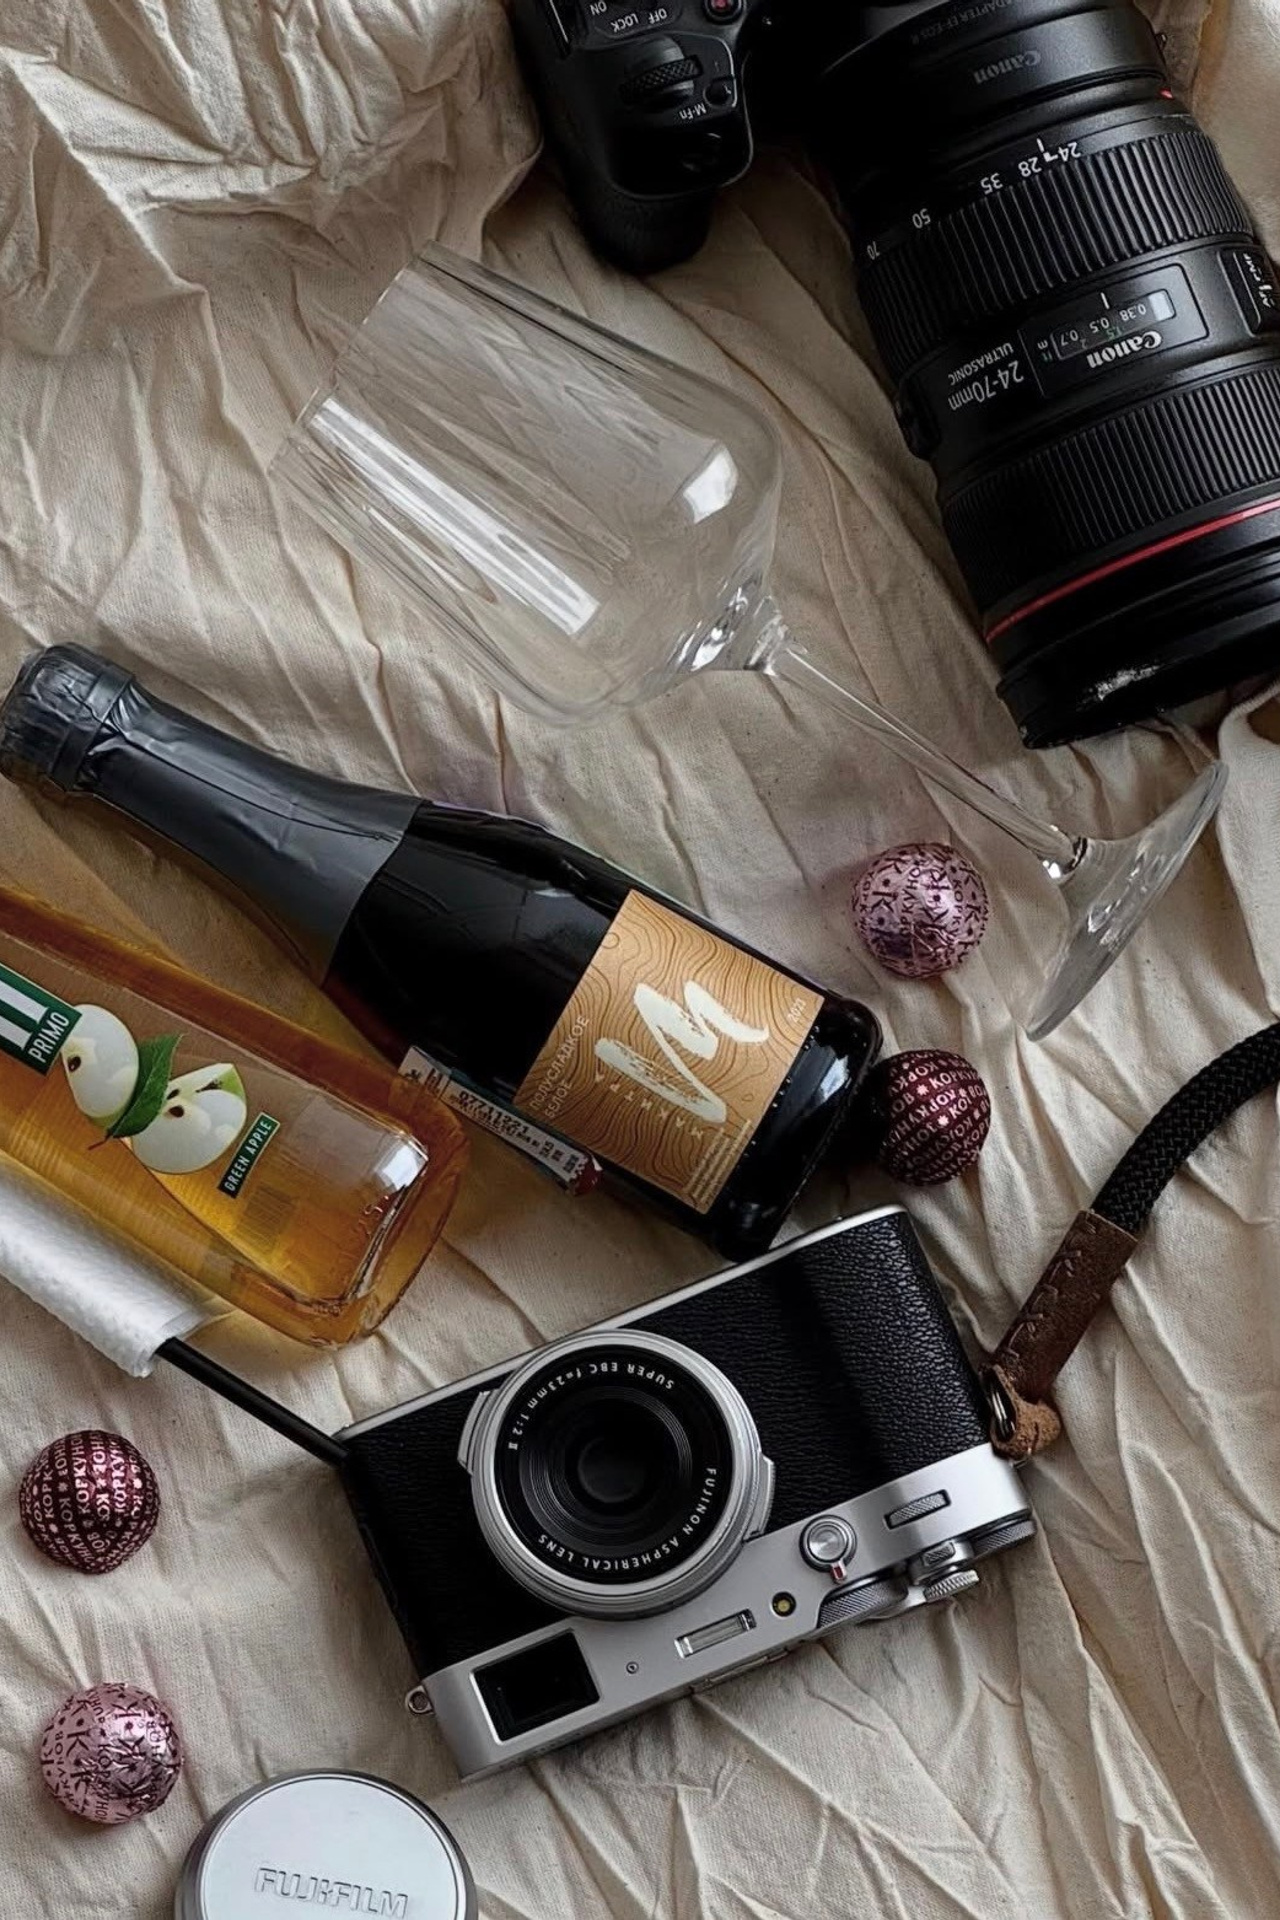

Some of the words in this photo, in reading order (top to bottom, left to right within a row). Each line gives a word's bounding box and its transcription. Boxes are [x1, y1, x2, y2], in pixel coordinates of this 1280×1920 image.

[590, 0, 607, 16] ON
[648, 7, 668, 25] OFF
[610, 13, 640, 33] LOCK
[972, 50, 1042, 84] Canon
[1057, 141, 1082, 163] 24
[1017, 155, 1042, 178] 28
[980, 172, 1003, 195] 35
[912, 207, 931, 229] 50
[866, 240, 881, 261] 70
[1088, 317, 1110, 334] 0.5
[1118, 302, 1147, 322] 0.38
[1059, 329, 1080, 347] 0.7
[1085, 330, 1163, 369] Canon
[947, 342, 1014, 386] ULTRASONIC
[947, 359, 1025, 411] 24-70mm
[27, 1011, 70, 1063] PRIMO
[529, 1015, 590, 1110] ПОЛУСЛАДКОЕ
[544, 1080, 573, 1119] БЕЛОЕ
[224, 1154, 250, 1192] GREEN
[247, 1120, 272, 1154] APPLE
[589, 1361, 618, 1374] EBC
[627, 1363, 675, 1389] SUPER
[527, 1367, 582, 1409] f=23mm
[682, 1467, 717, 1535] FUJINON
[538, 1534, 574, 1562] LENS
[583, 1536, 680, 1570] ASPHERICAL
[254, 1866, 409, 1919] FUJIFILM
